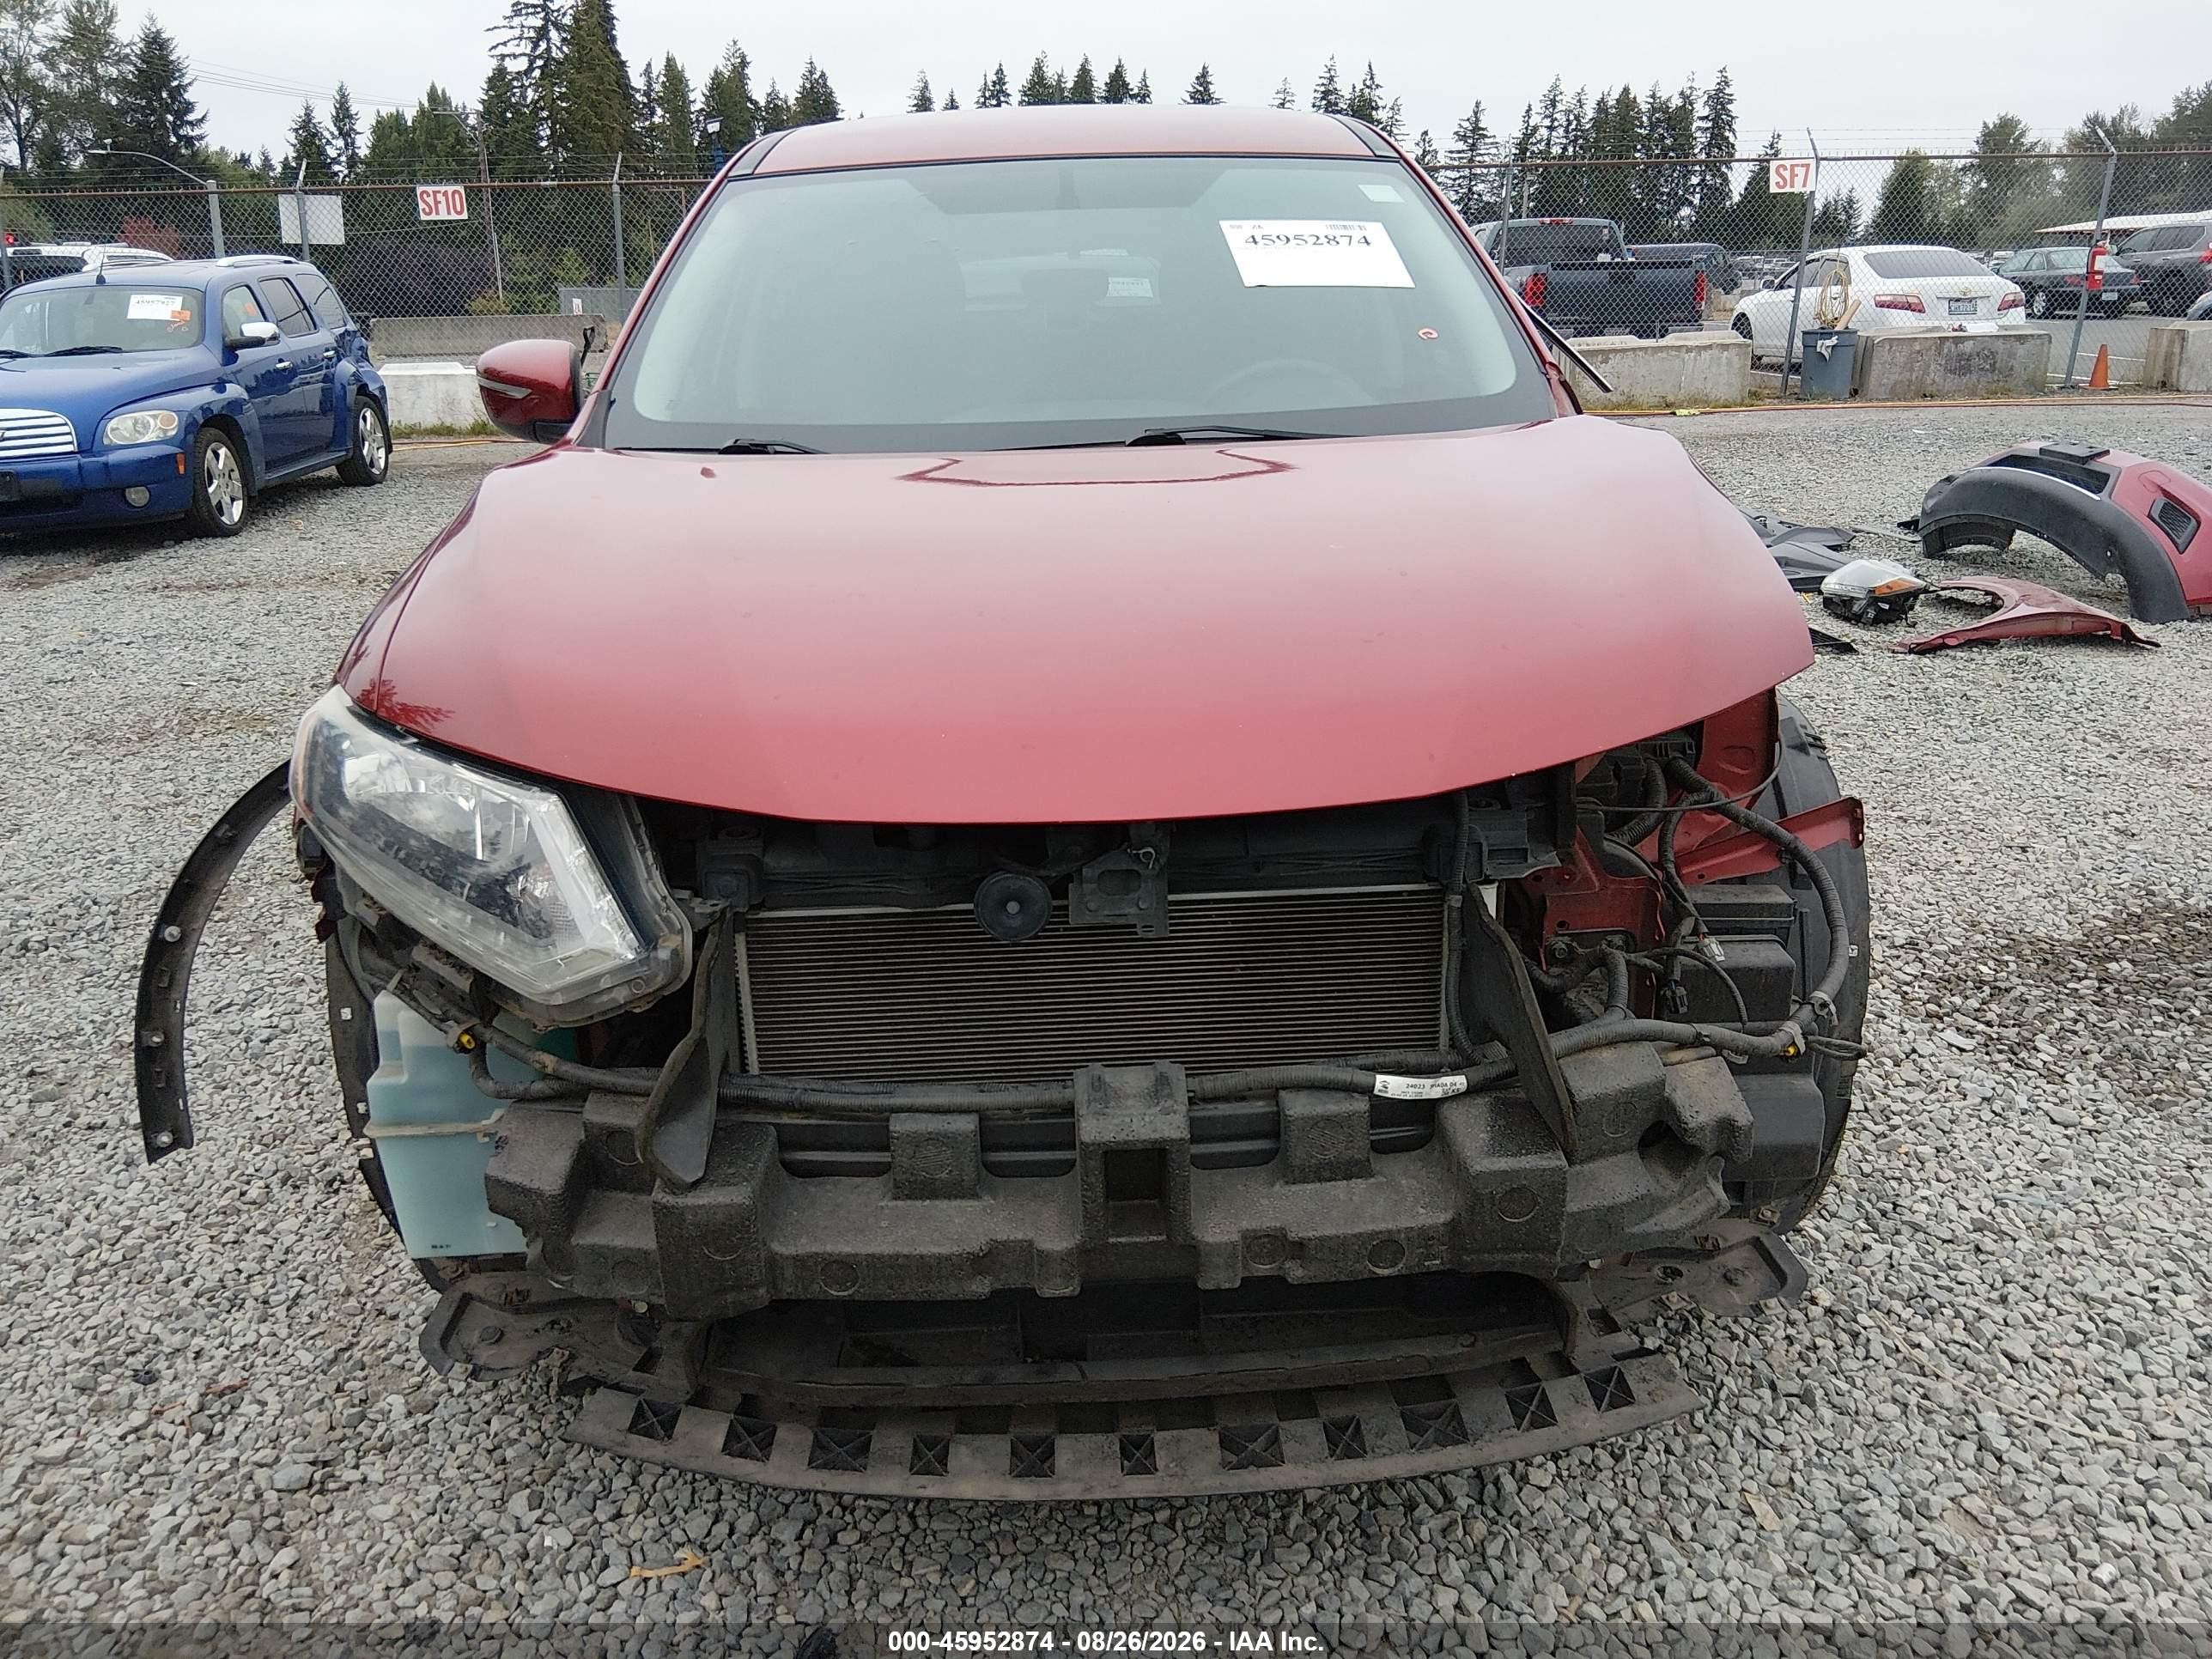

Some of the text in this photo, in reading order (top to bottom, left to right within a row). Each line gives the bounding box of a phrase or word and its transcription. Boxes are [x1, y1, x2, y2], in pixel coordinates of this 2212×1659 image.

[1775, 163, 1811, 189] SF7
[419, 189, 465, 216] SF10
[1244, 234, 1372, 246] 45952874
